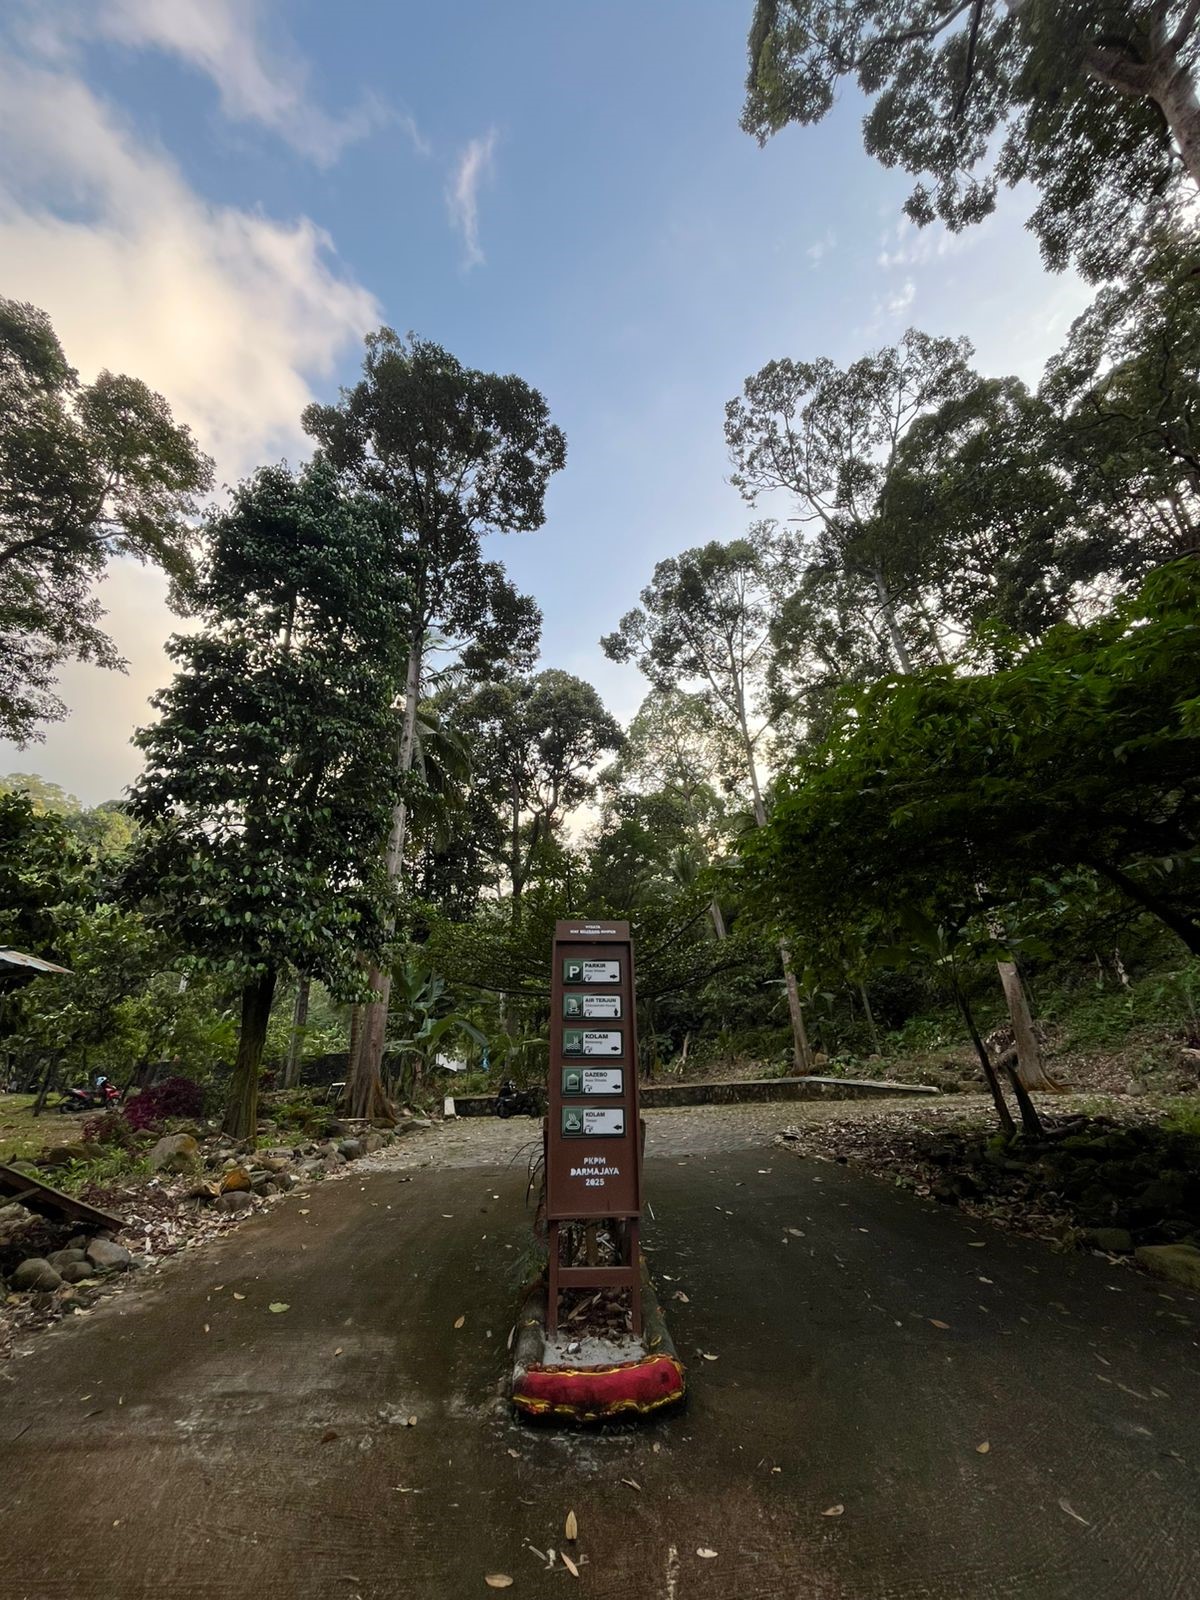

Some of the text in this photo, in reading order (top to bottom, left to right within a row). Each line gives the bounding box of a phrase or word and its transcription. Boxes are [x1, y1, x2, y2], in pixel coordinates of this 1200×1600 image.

[569, 966, 580, 978] P
[583, 1157, 606, 1165] PKPM
[570, 1167, 620, 1176] DARMAJAYA
[585, 1178, 605, 1186] 2025
